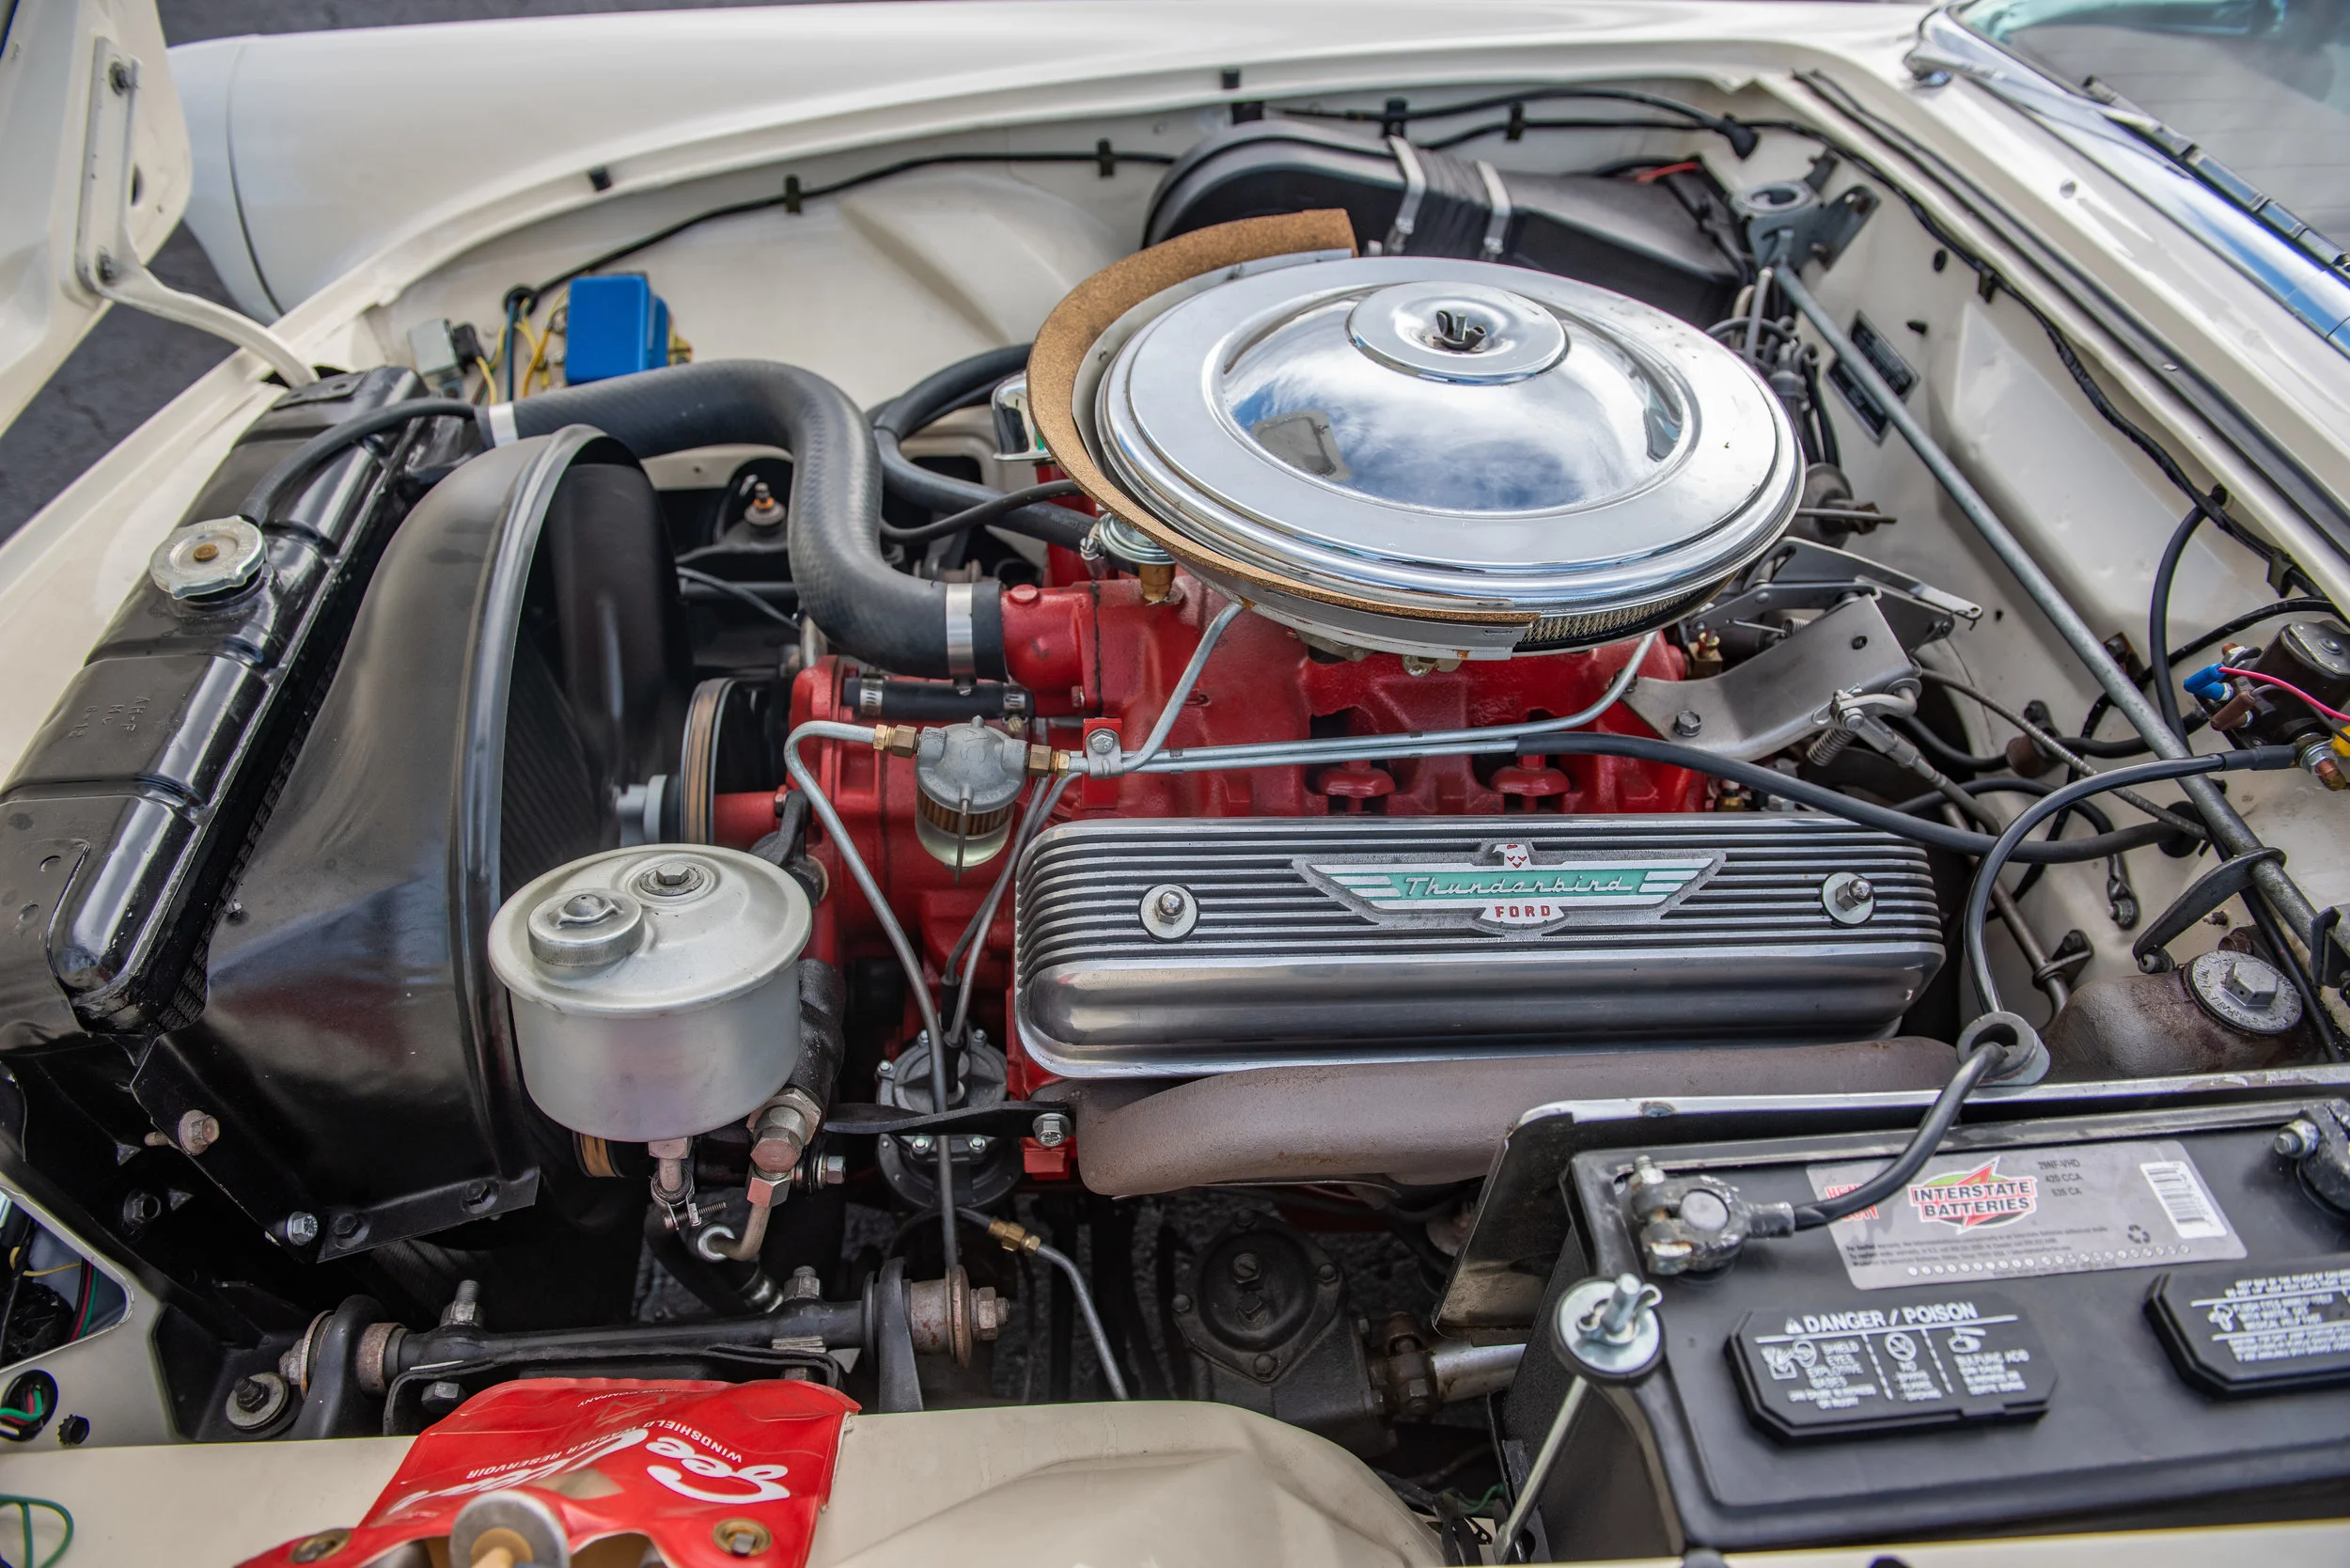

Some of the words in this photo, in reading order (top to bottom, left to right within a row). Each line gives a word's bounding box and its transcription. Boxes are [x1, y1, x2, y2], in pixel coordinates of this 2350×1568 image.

[1403, 873, 1634, 896] Thunderbird
[1495, 904, 1551, 918] FORD
[2061, 1172, 2083, 1183] CCA
[1914, 1181, 2031, 1202] INTERSTATE
[2068, 1186, 2083, 1196] CA
[1924, 1197, 2030, 1217] BATTERIES
[1802, 1309, 1887, 1333] DANGER
[1889, 1308, 1899, 1325] /
[1901, 1301, 1978, 1324] POISON
[645, 1419, 743, 1464] WINDSHIELD
[466, 1450, 563, 1480] RESERVOIR
[645, 1435, 791, 1505] See
